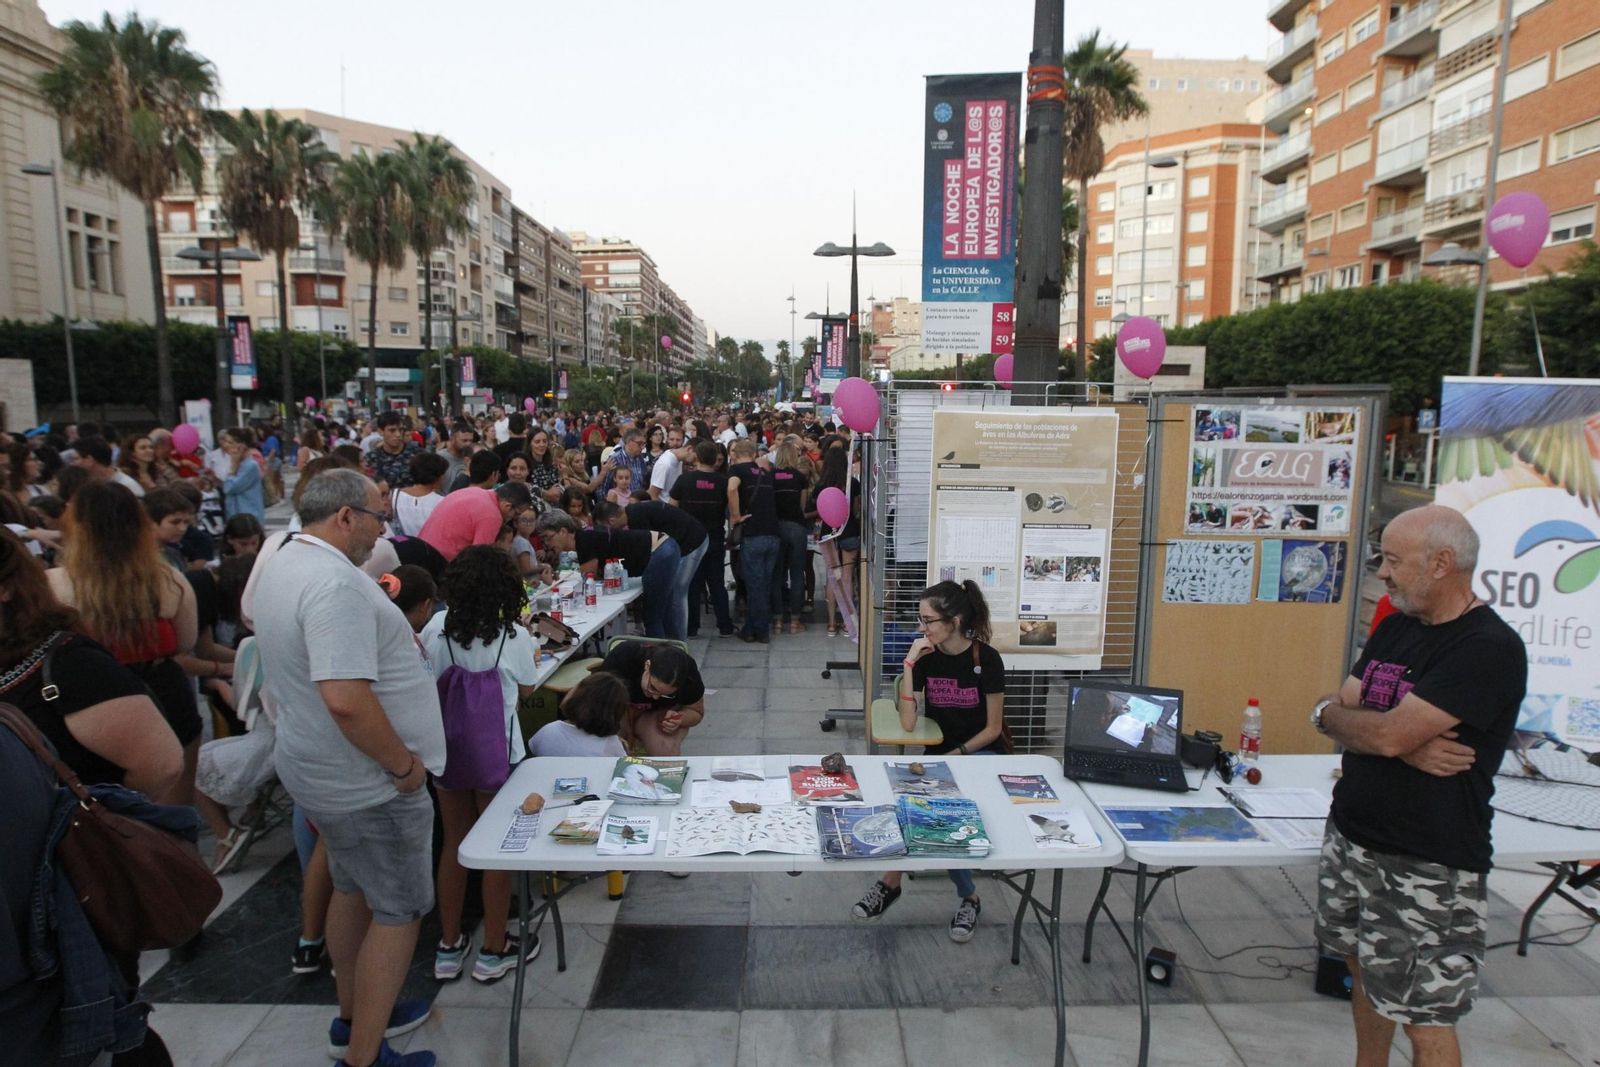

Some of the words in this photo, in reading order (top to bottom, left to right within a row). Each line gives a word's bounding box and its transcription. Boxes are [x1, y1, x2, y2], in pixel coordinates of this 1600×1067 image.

[968, 105, 983, 143] L@S
[967, 147, 982, 170] DE
[984, 105, 1003, 255] INVESTIGADOR@S
[946, 164, 962, 224] NOCHE
[964, 176, 980, 255] EUROPEA
[945, 232, 960, 255] LA
[996, 312, 1010, 322] 58
[996, 335, 1009, 345] 59
[975, 421, 1013, 430] Seguimiento
[1423, 411, 1434, 425] P
[1480, 569, 1540, 609] SEO
[1507, 614, 1592, 649] dLife
[1537, 656, 1572, 666] ALMERÍA
